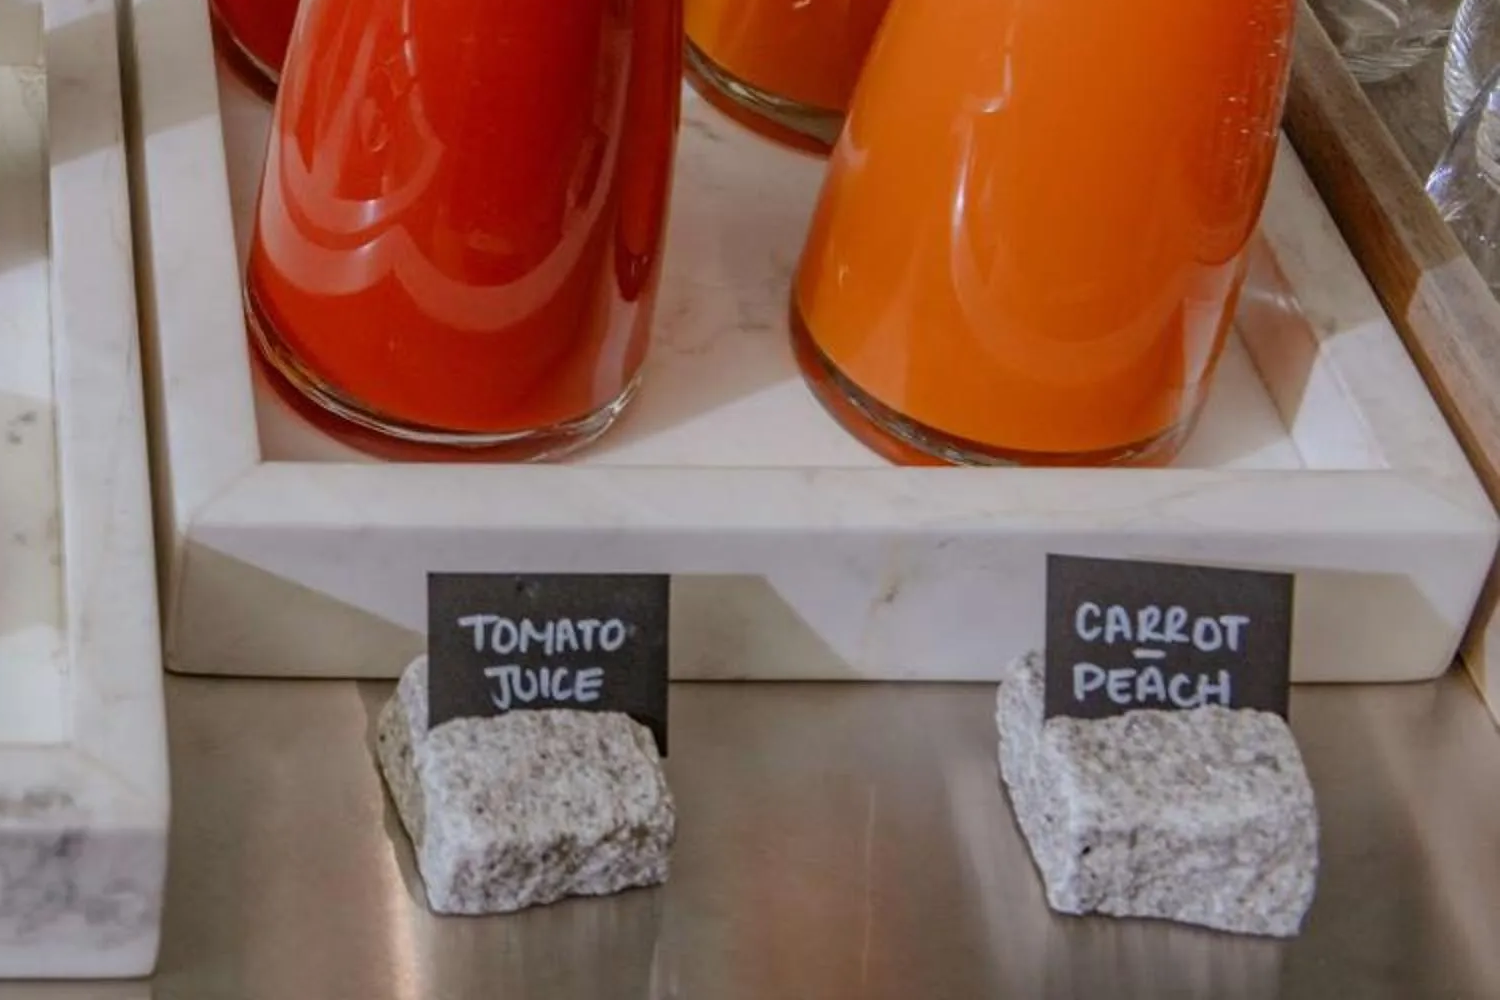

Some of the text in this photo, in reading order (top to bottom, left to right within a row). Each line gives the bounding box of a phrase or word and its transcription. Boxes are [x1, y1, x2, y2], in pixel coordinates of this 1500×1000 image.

[457, 613, 626, 655] TOMATO
[1075, 601, 1250, 651] CARROT
[484, 664, 605, 711] JUICE
[1072, 662, 1231, 708] PEACH
